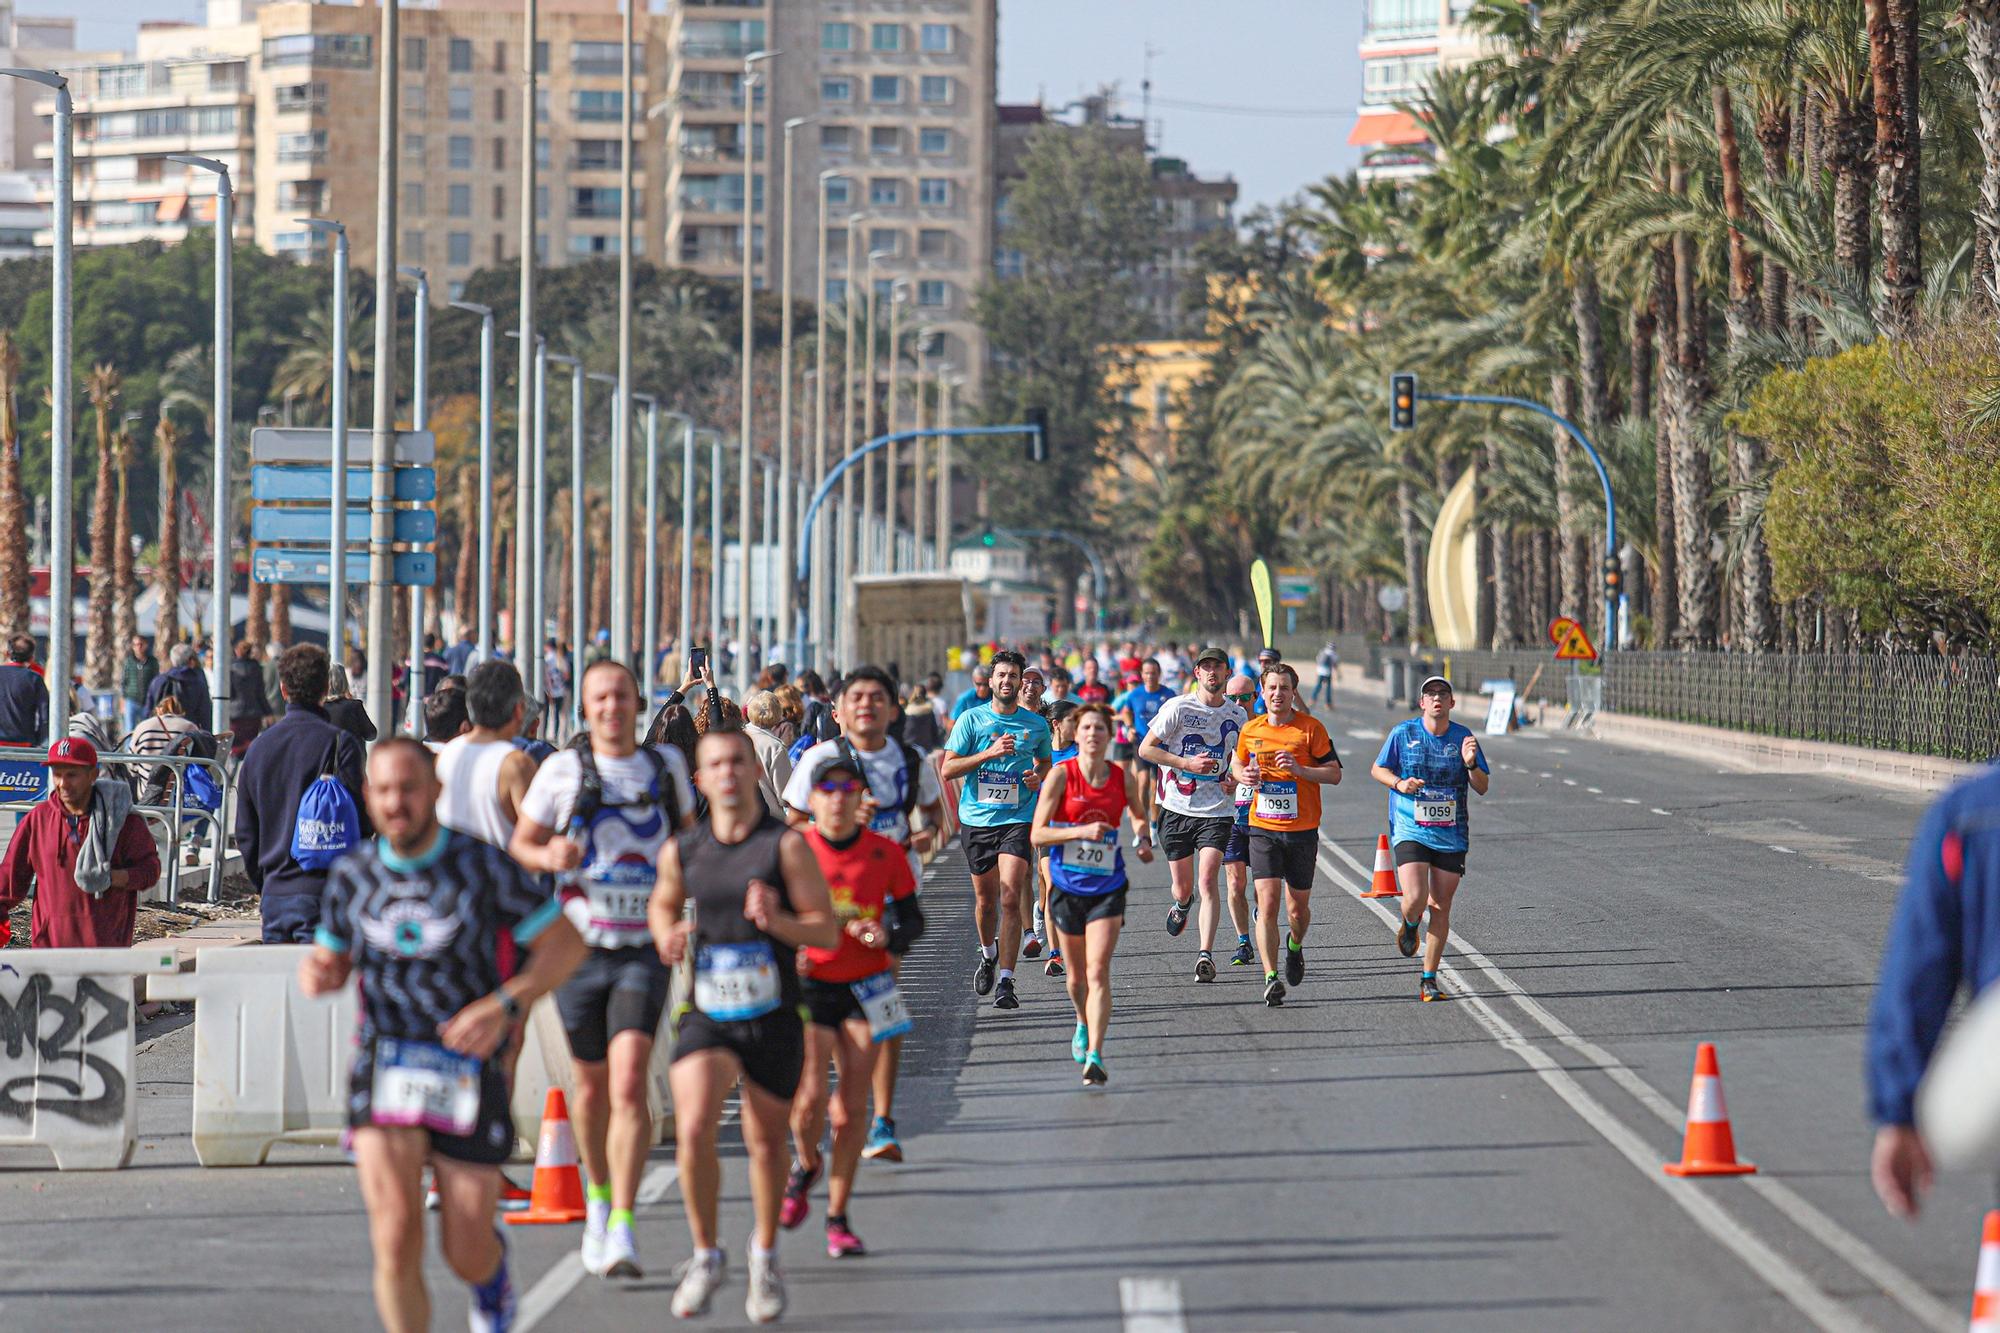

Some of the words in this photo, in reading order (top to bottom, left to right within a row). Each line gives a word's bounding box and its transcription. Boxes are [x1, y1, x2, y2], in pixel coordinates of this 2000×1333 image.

[987, 788, 1010, 800] 727
[1241, 787, 1254, 797] 27
[1443, 793, 1454, 801] 21K
[1264, 798, 1290, 810] 1093
[1422, 806, 1451, 817] 1059
[1076, 846, 1103, 863] 270
